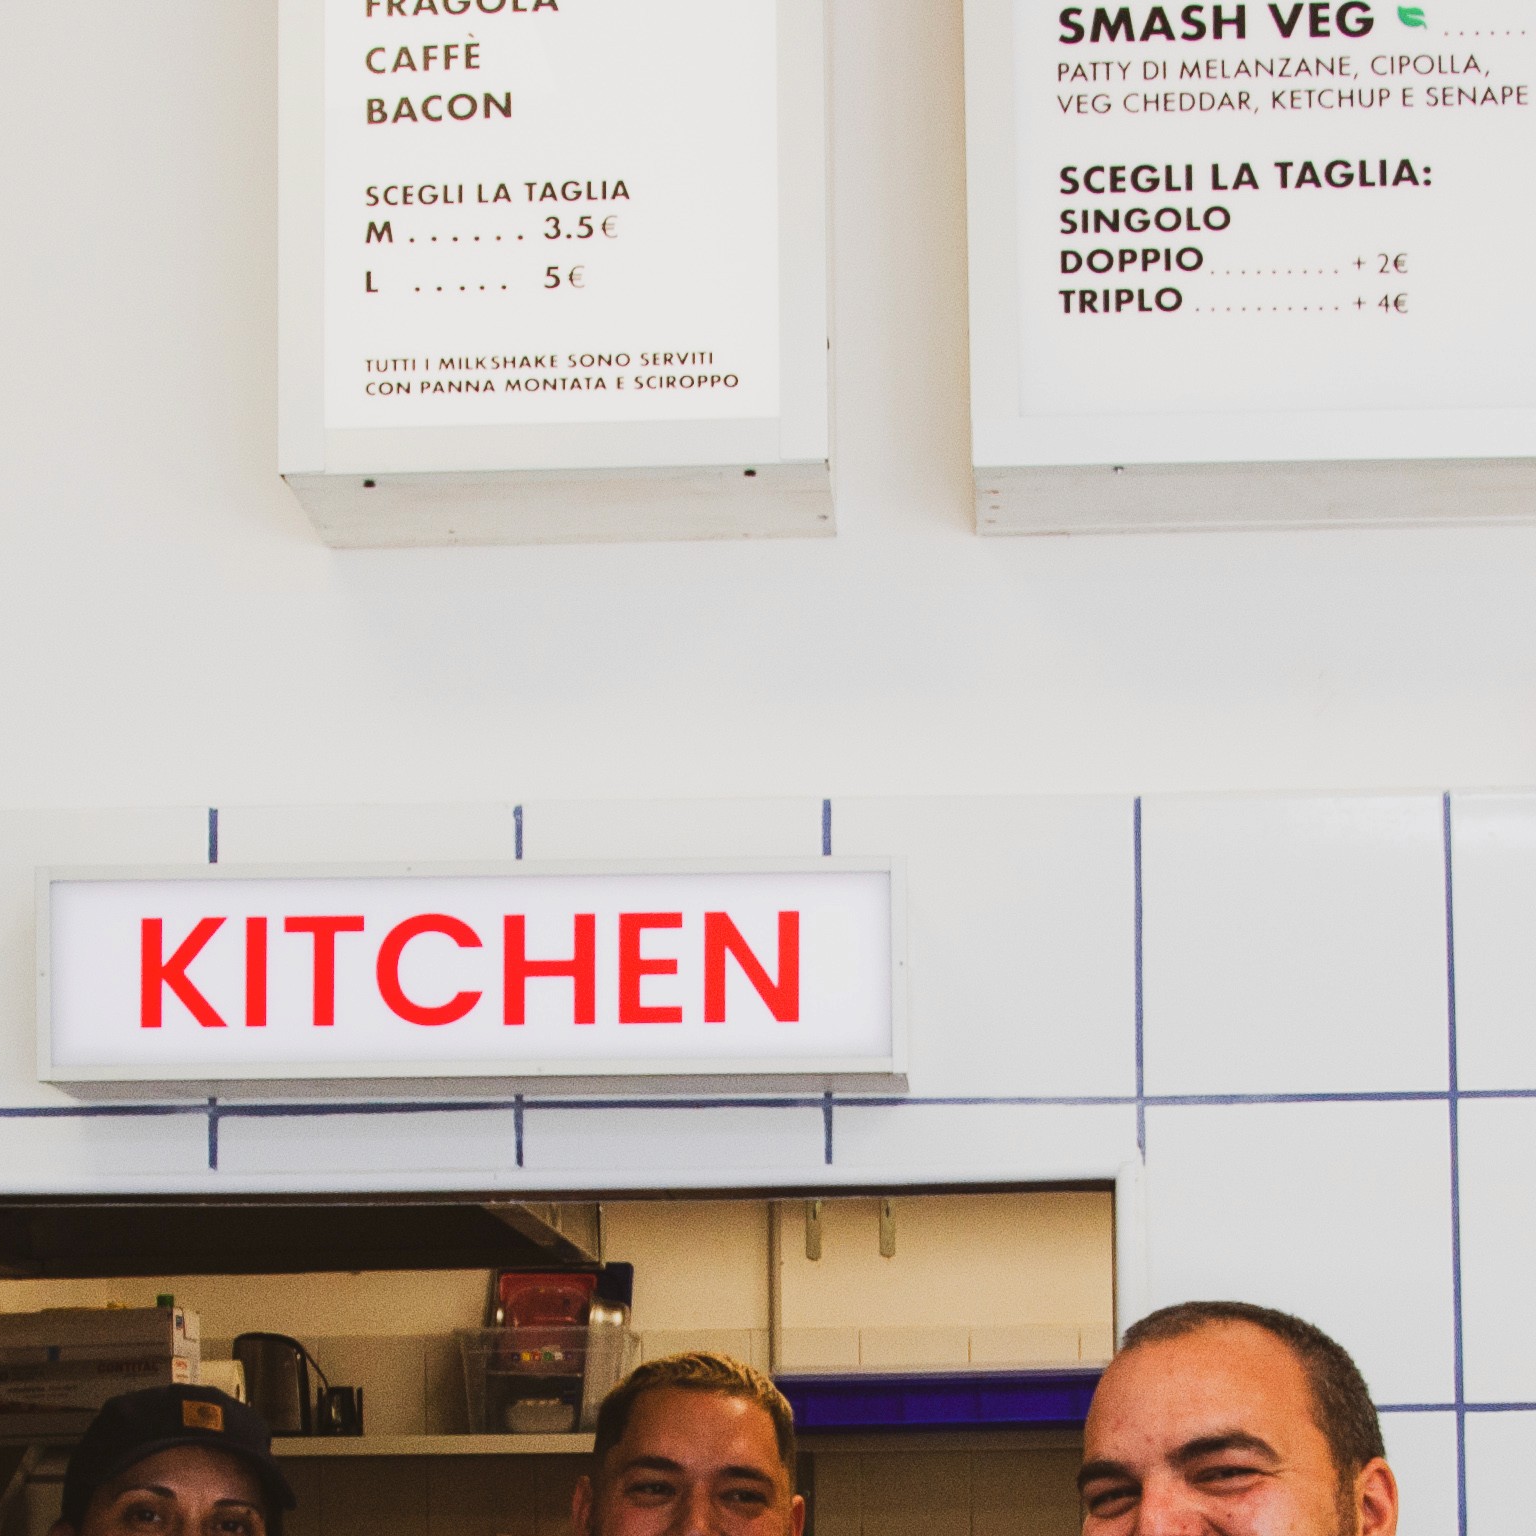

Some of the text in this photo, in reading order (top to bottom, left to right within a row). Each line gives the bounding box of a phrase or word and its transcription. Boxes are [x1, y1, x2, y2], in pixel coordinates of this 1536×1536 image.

[1059, 4, 1246, 45] SMASH
[1268, 0, 1374, 39] VEG
[365, 33, 481, 74] CAFFÈ
[1058, 54, 1489, 82] PATTY DI MELANZANE, CIPOLLA,
[367, 92, 512, 124] BACON
[1057, 86, 1526, 114] VEG CHEDDAR, KETCHUP E SENAPE
[1060, 159, 1431, 195] SCEGLI LA TAGLIA:
[366, 180, 629, 207] SCEGLI LA TAGLIA
[366, 221, 393, 243] M
[1060, 206, 1231, 235] SINGOLO
[1061, 246, 1203, 274] DOPPIO
[1378, 254, 1409, 274] 2€
[366, 271, 378, 293] L
[1059, 287, 1182, 314] TRIPLO
[1378, 294, 1409, 313] 4€
[366, 352, 713, 372] TUTTI I MILKSHAKE SONO SERVITI
[366, 374, 739, 395] CON PANNA MONTATA E SCIROPPO
[140, 911, 800, 1028] KITCHEN
